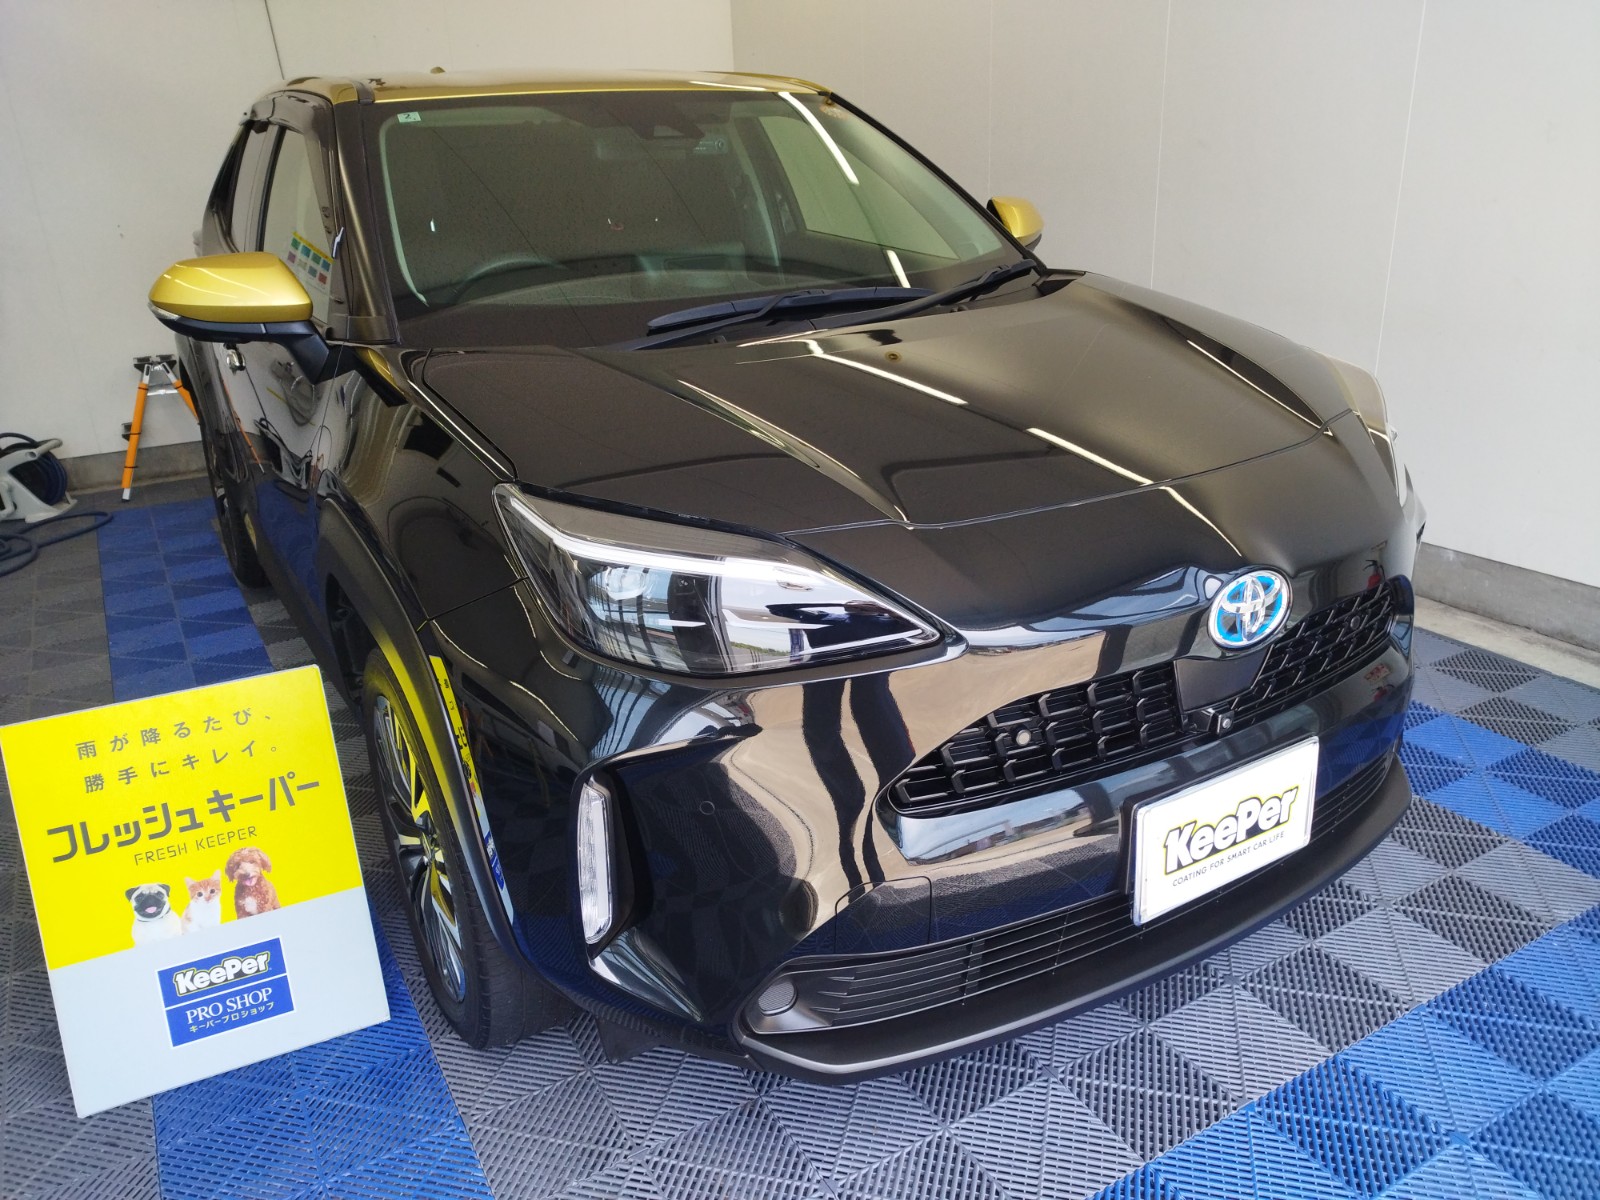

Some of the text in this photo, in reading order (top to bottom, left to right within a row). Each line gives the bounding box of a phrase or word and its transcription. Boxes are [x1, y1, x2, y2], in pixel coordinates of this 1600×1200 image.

[76, 708, 271, 761] 雨が降るたび、
[84, 740, 278, 794] 勝手にキレイ。
[47, 771, 320, 864] フレッシュキーパー
[1163, 785, 1299, 876] KeePer
[134, 825, 258, 866] FRESH KEEPER
[1172, 830, 1285, 887] COATING FOR SMART CAR LIFE
[173, 950, 270, 997] KeePer
[185, 987, 273, 1025] PRO SHOP
